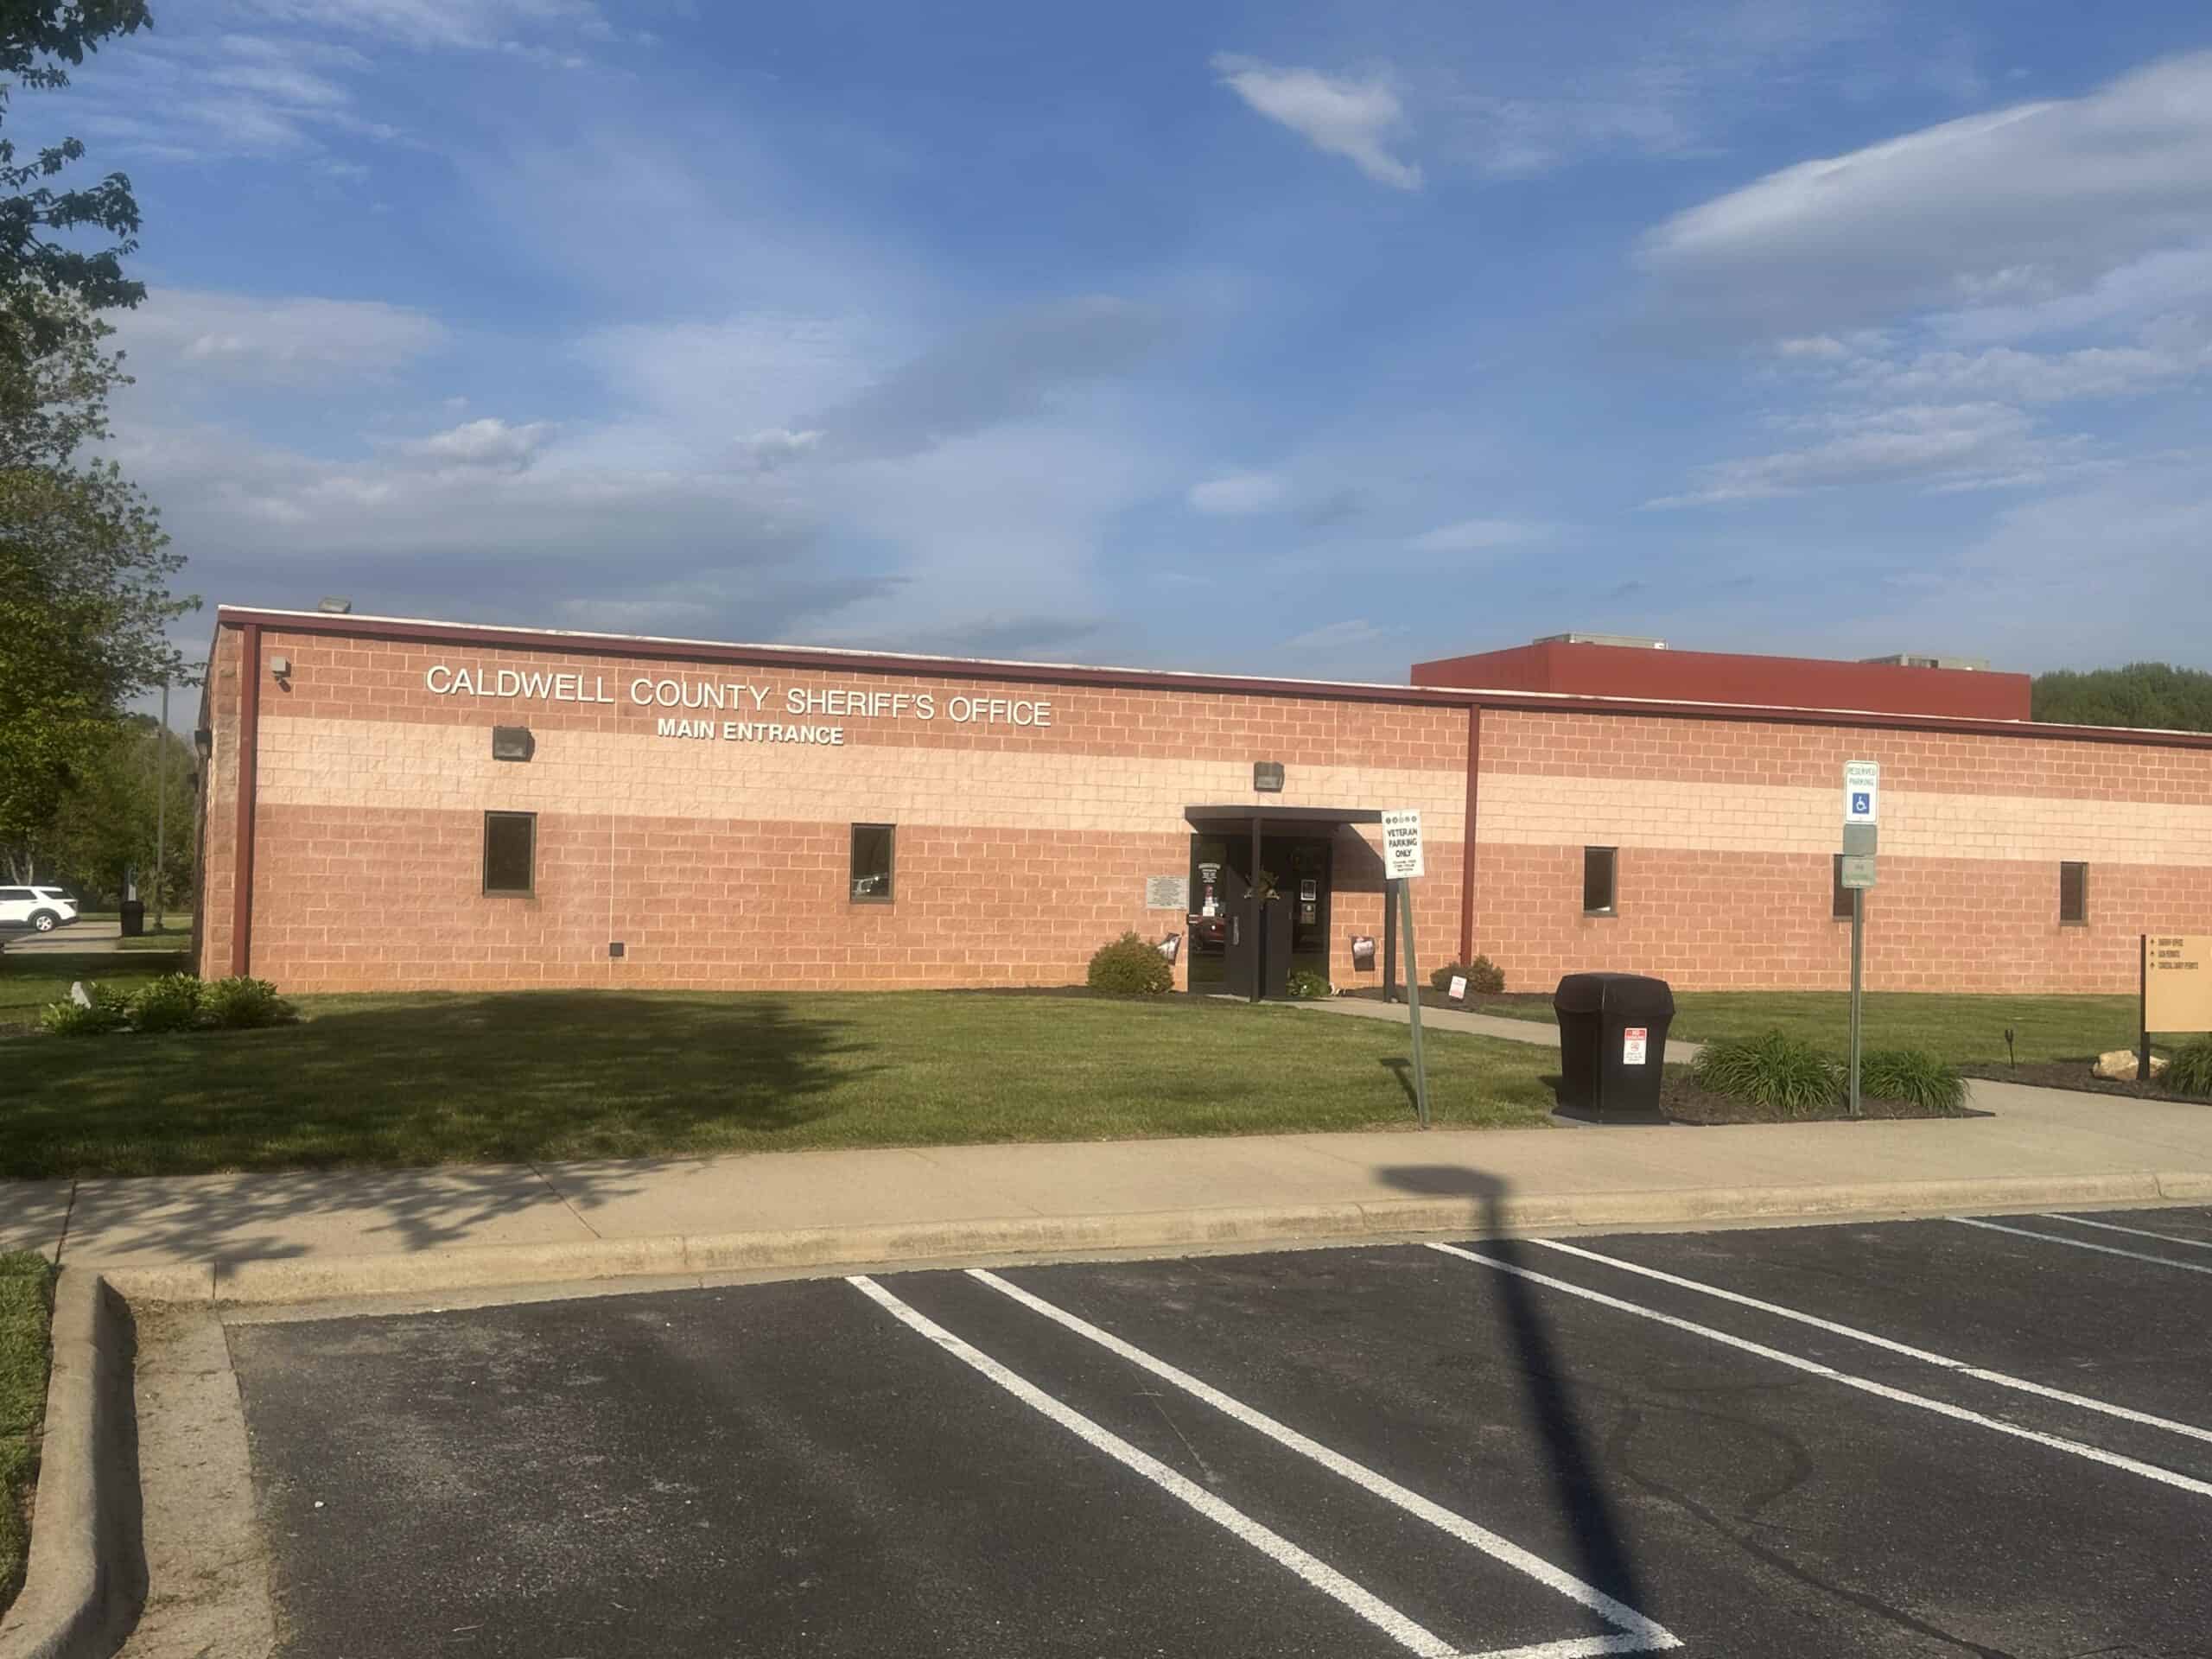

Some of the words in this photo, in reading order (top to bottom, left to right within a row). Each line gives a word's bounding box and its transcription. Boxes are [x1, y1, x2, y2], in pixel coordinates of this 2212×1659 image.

[426, 665, 614, 703] CALDWELL
[630, 678, 770, 711] COUNTY
[786, 688, 936, 720] SHERIFF'S
[949, 696, 1052, 727] OFFICE
[658, 718, 715, 740] MAIN
[723, 721, 844, 745] ENTRANCE
[1389, 838, 1417, 848] PARKING
